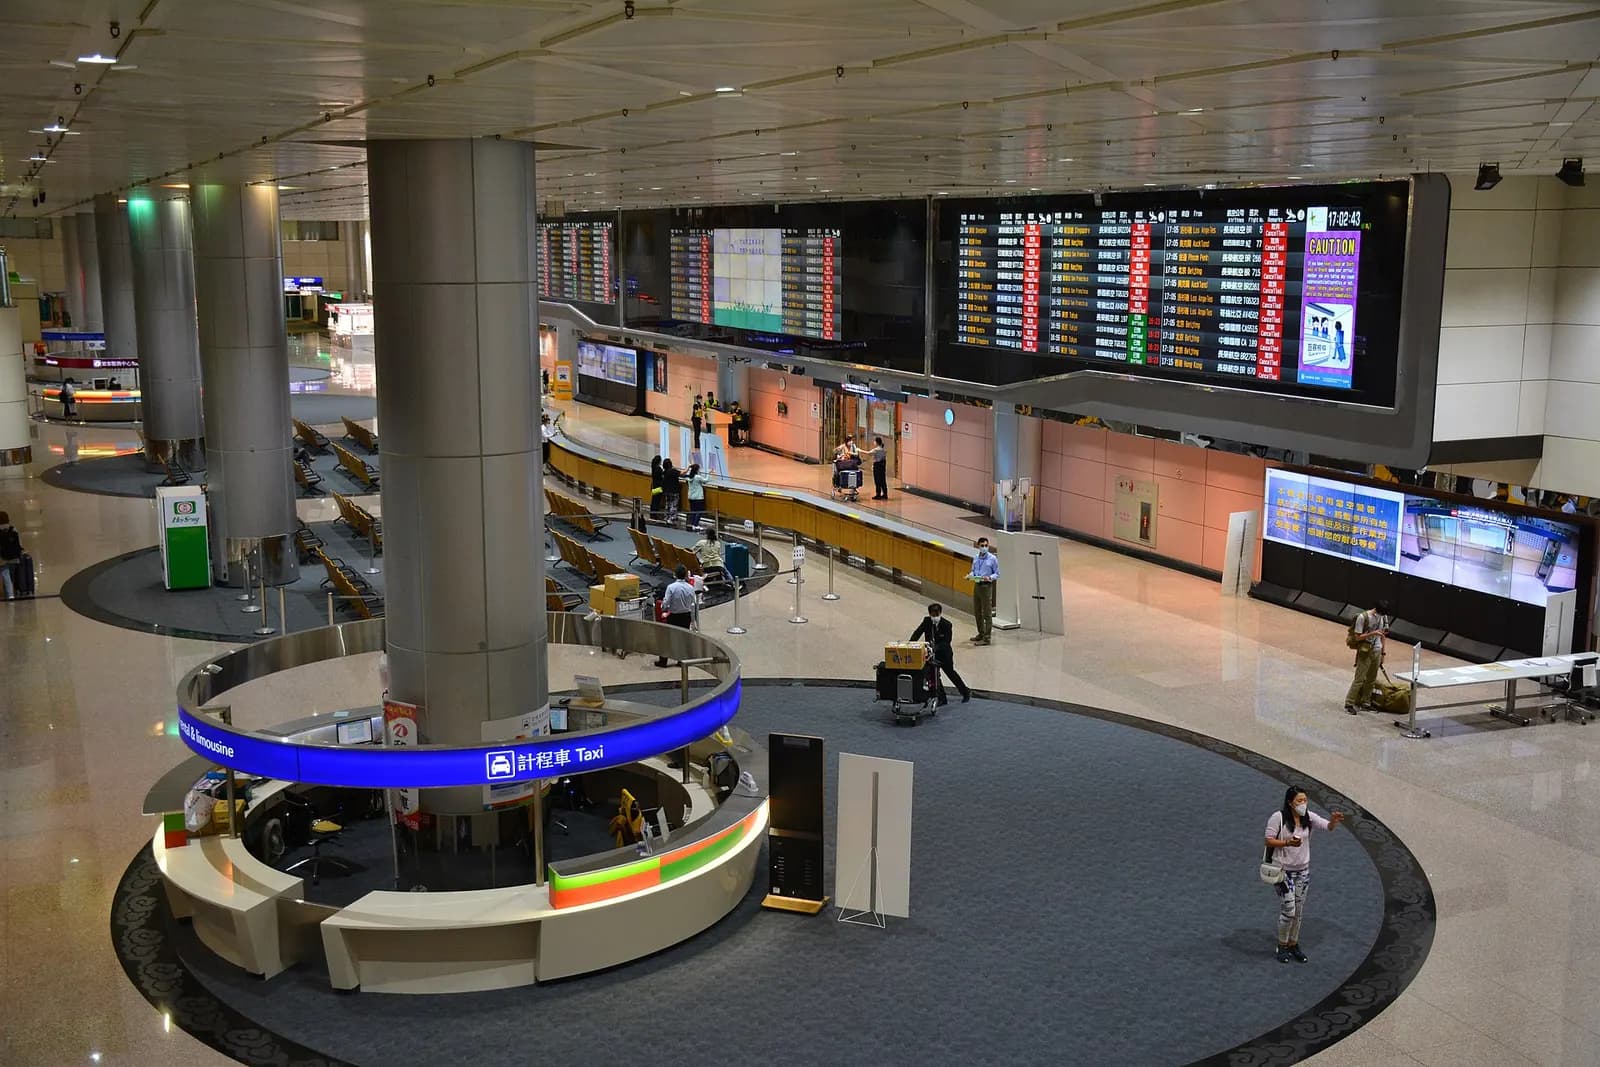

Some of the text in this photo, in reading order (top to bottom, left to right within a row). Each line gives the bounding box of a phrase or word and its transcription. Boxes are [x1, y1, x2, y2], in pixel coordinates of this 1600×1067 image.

[1328, 211, 1360, 227] 17:02:43
[1166, 239, 1179, 247] 17:05
[1256, 240, 1262, 248] 77
[1310, 238, 1355, 255] CAUTION
[1166, 253, 1178, 261] 17:05
[1165, 266, 1178, 274] 17:05
[191, 727, 195, 741] &
[196, 729, 234, 757] limousine
[518, 745, 604, 771] 計程車 Taxi
